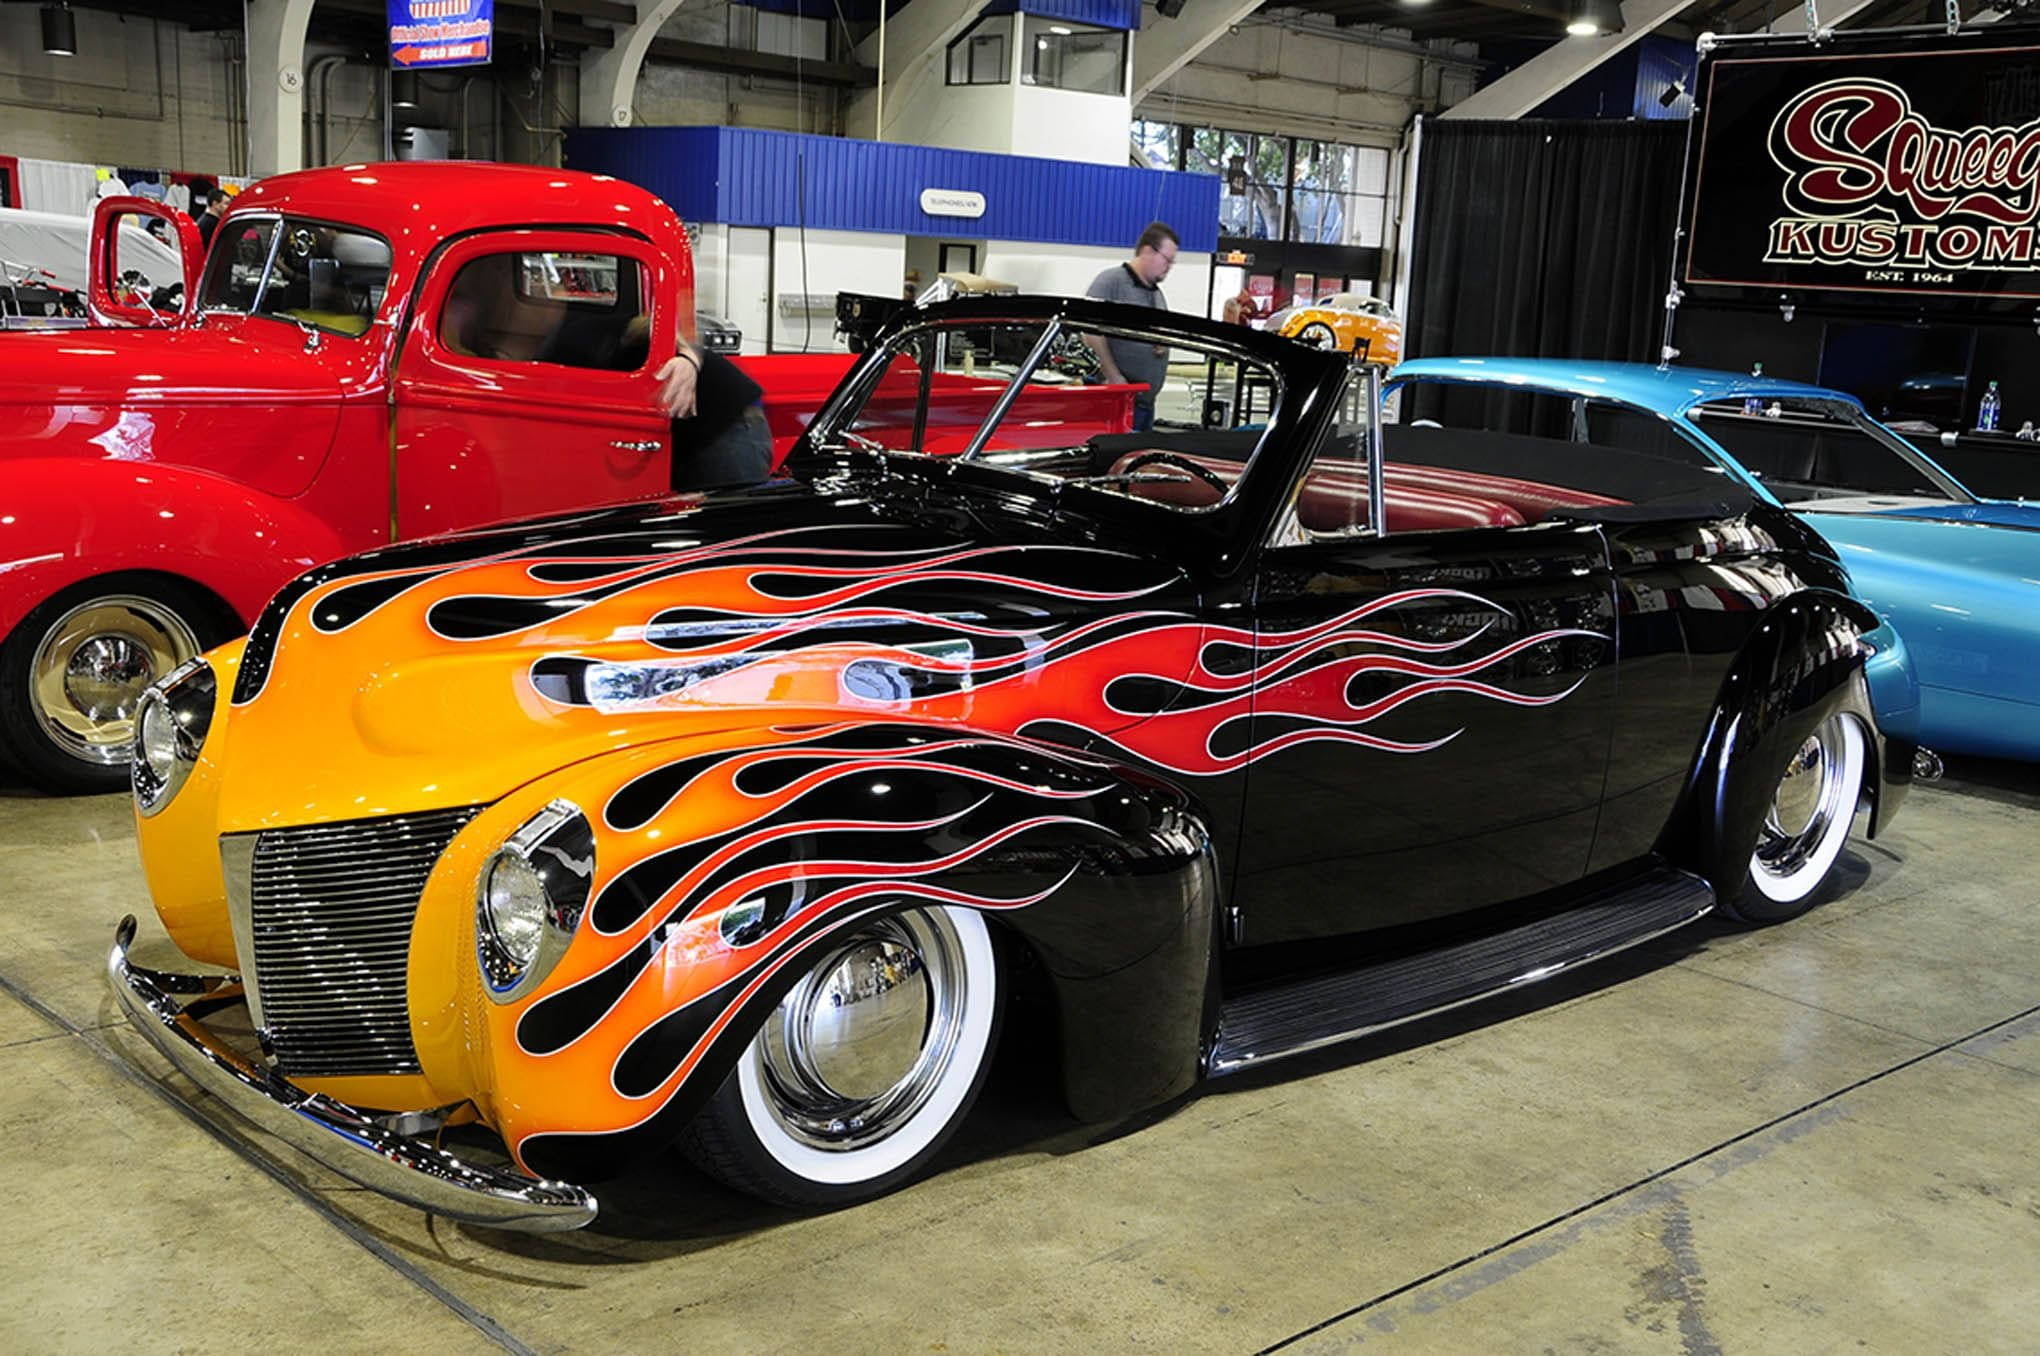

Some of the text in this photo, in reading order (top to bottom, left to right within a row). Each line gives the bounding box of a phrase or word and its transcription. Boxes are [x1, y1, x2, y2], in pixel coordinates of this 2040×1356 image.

[419, 44, 473, 60] SOLD HERE
[1768, 219, 2039, 266] KUSTOM
[1865, 270, 1954, 283] EST. 1964
